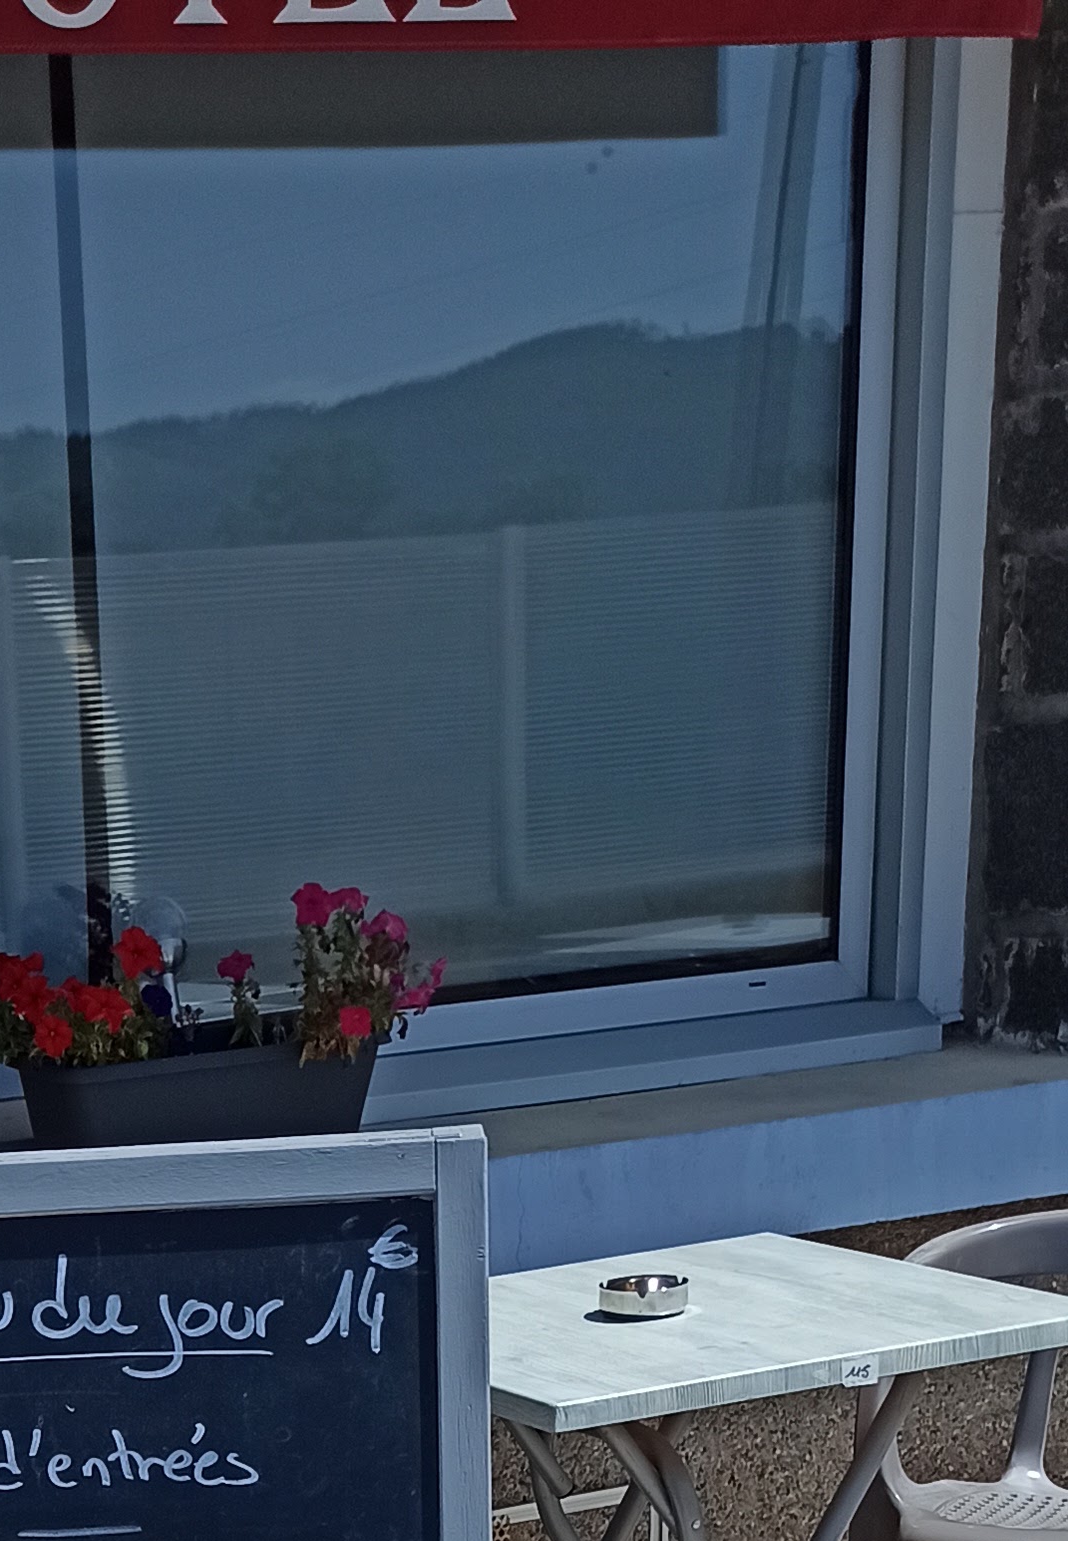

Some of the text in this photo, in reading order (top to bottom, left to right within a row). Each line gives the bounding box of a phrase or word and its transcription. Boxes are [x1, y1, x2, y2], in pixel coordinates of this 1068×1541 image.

[31, 1253, 139, 1340] du
[121, 1293, 285, 1380] jour
[305, 1266, 385, 1354] 14
